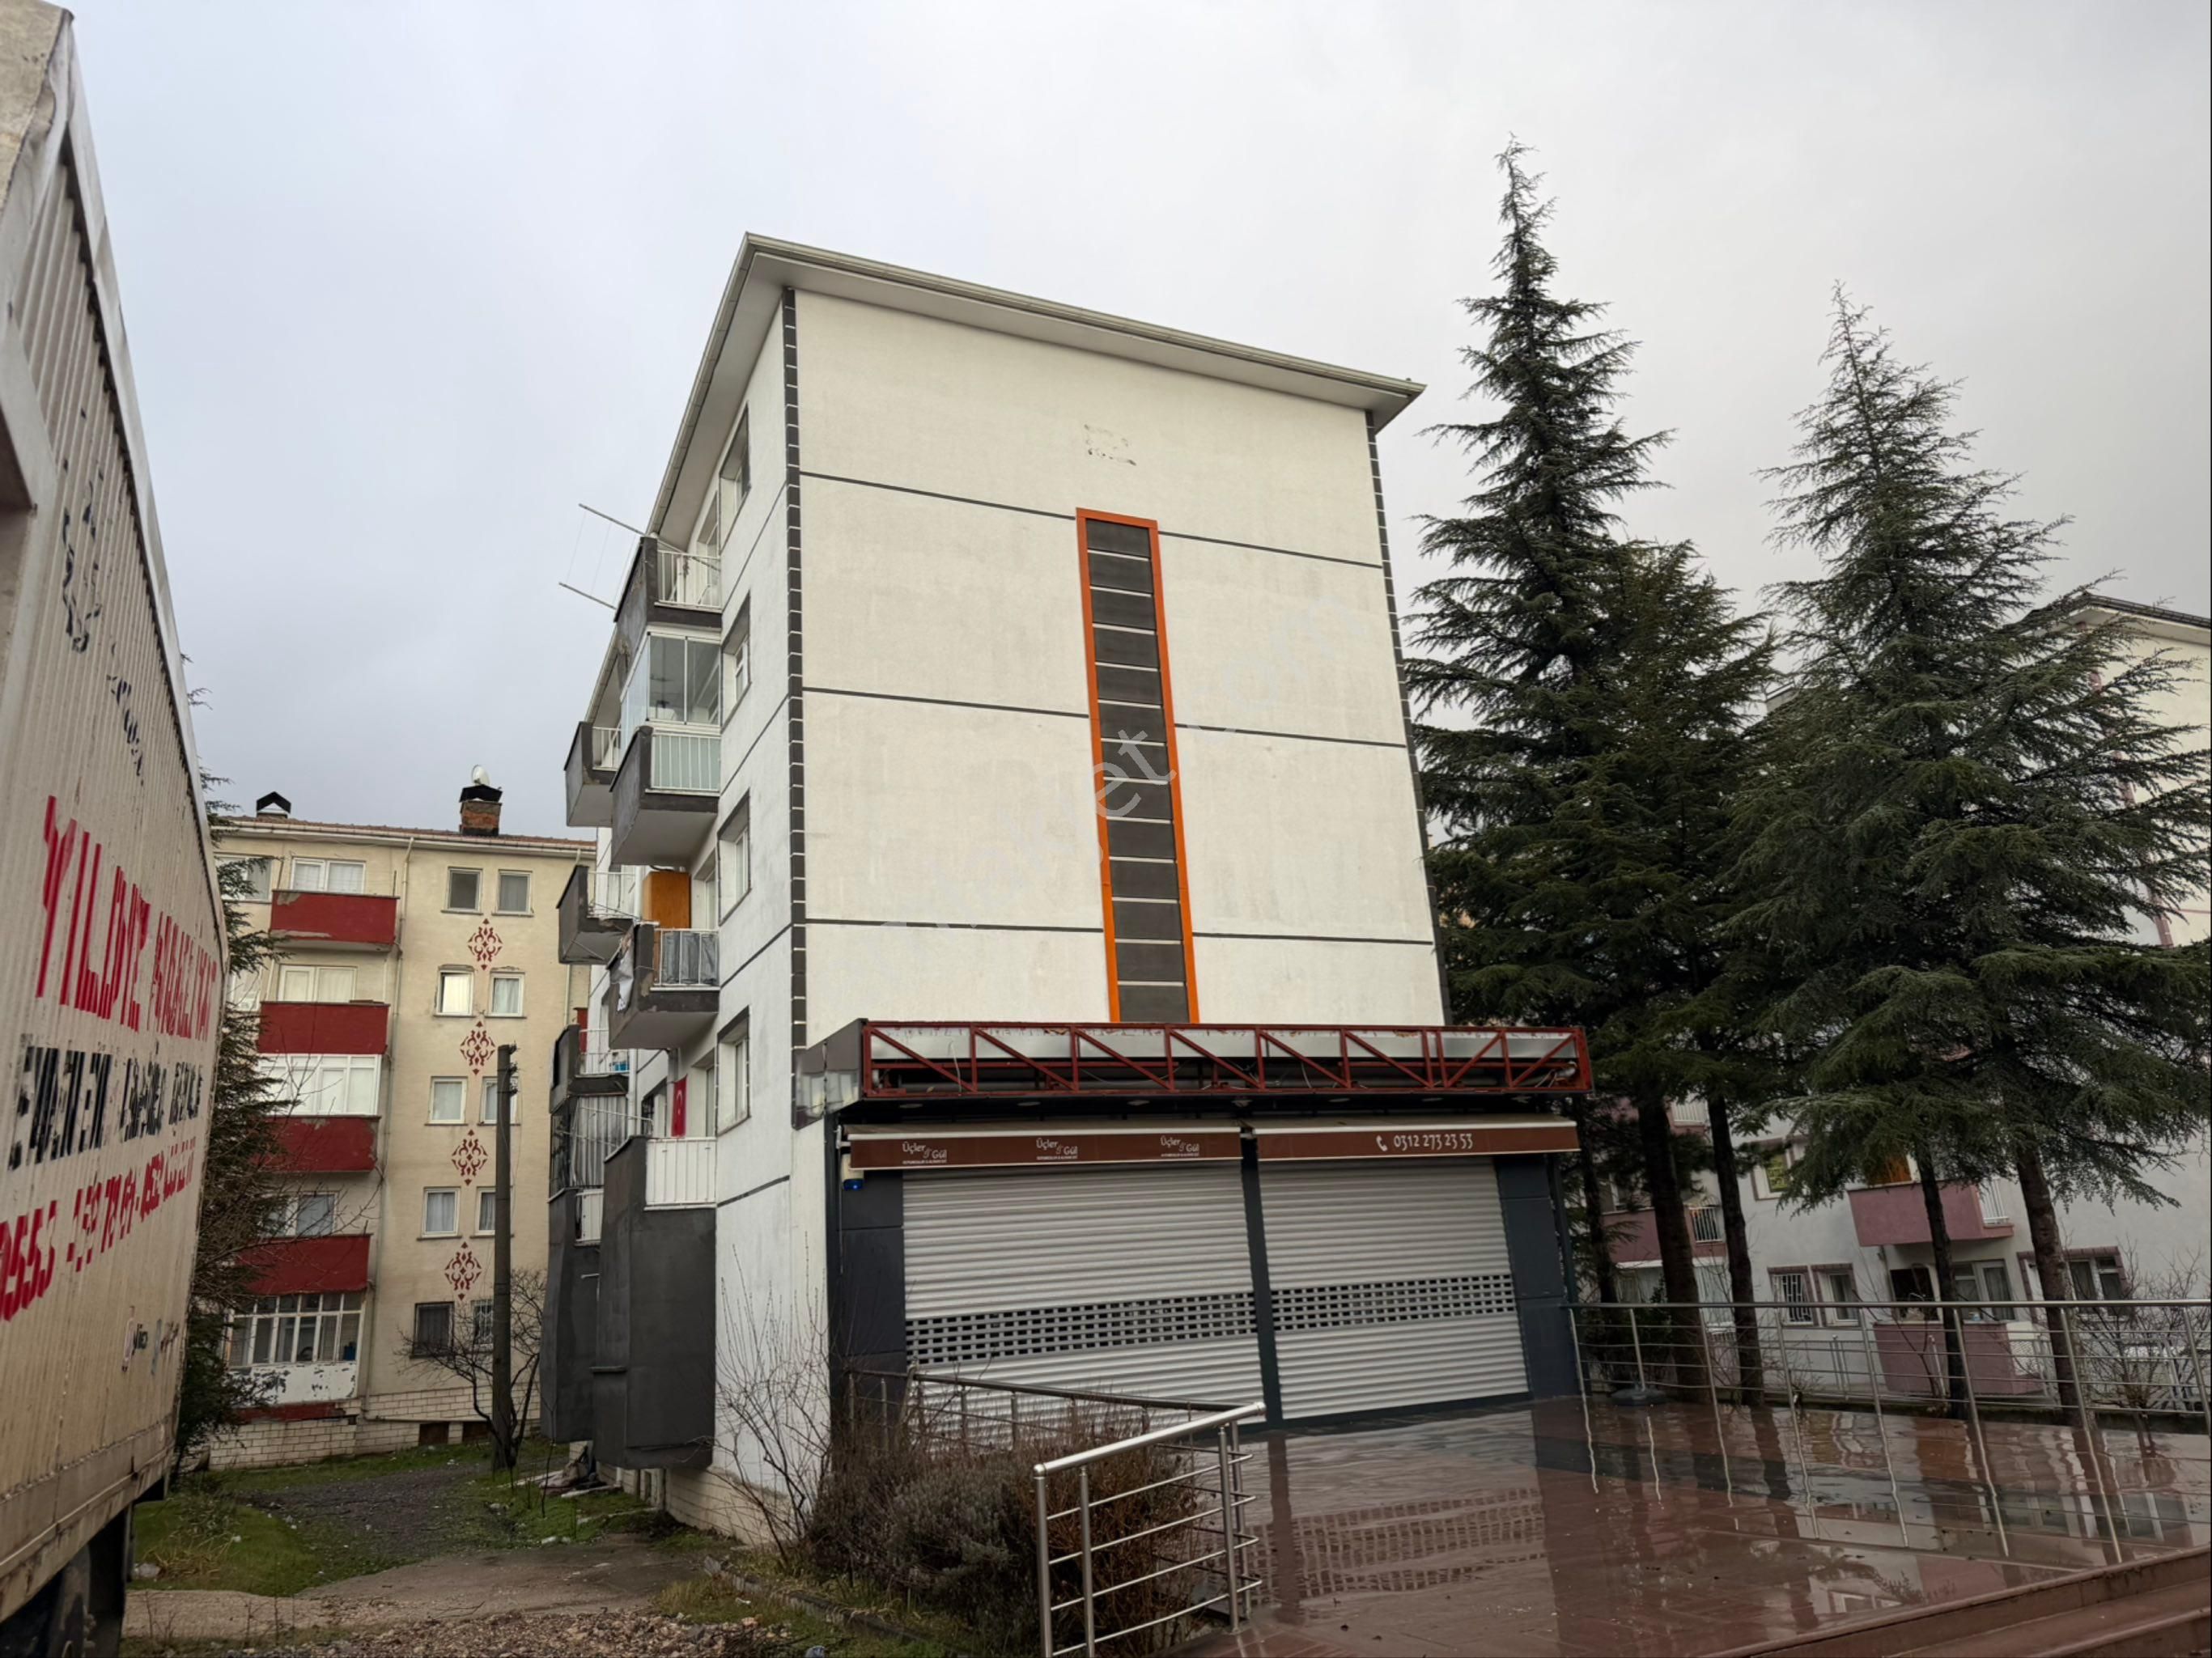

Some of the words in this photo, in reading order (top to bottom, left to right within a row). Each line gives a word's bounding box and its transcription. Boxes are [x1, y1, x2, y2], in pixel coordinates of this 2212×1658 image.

[36, 795, 151, 1033] YILDIZ
[902, 1141, 926, 1154] Üçler
[931, 1149, 948, 1159] Gül
[1036, 1138, 1059, 1151] Üçler
[1064, 1146, 1078, 1156] Gül
[1161, 1135, 1181, 1148] Üçler
[1186, 1143, 1199, 1152] Gül
[1394, 1134, 1420, 1151] 0312
[1423, 1134, 1442, 1151] 273
[1444, 1134, 1458, 1149] 23
[1460, 1133, 1473, 1149] 53
